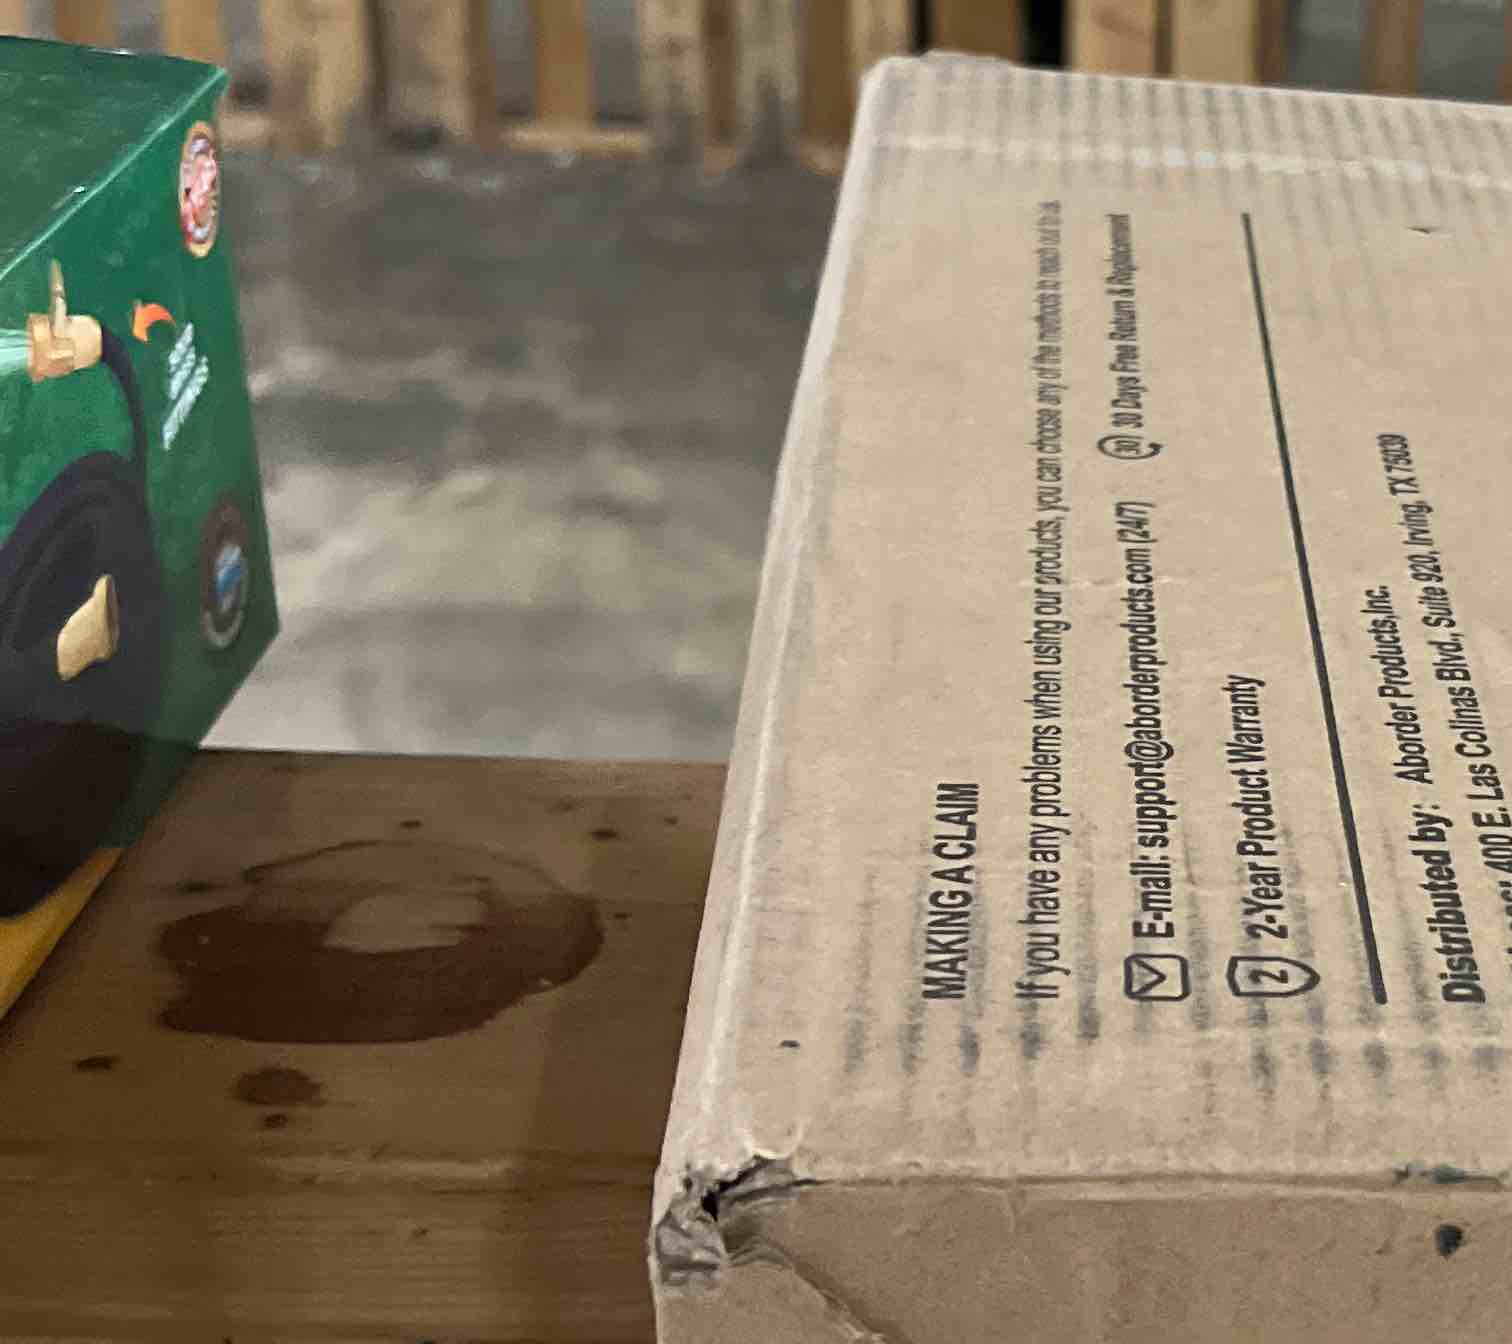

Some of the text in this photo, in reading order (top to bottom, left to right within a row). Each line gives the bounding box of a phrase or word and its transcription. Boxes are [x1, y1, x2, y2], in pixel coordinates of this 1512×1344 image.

[1106, 288, 1136, 297] &
[1108, 300, 1138, 342] Return
[1031, 345, 1062, 364] the
[1032, 365, 1062, 379] of
[1109, 344, 1141, 372] Free
[1037, 382, 1069, 406] any
[1110, 376, 1149, 409] Days
[1025, 408, 1063, 454] choose
[1111, 412, 1143, 429] 30
[1036, 457, 1062, 483] can
[1388, 475, 1421, 496] TX
[1037, 485, 1070, 512] you
[1397, 500, 1434, 546] Irving,
[1027, 516, 1068, 584] products,
[1405, 550, 1444, 583] 920,
[1033, 587, 1062, 616] our
[1418, 585, 1456, 628] Suite
[1024, 620, 1071, 665] using
[1427, 633, 1472, 682] Blvd.,
[1023, 670, 1062, 719] when
[1115, 501, 1177, 939] E-mail: support@aborderproducts.com (24/7)
[1447, 686, 1492, 757] Colinas
[1383, 702, 1433, 785] Aborder
[1020, 724, 1072, 818] problems
[1466, 763, 1504, 800] Las
[1221, 674, 1291, 940] 2-Year Product Warranty
[1408, 804, 1453, 842] by:
[1470, 806, 1512, 828] E.
[1029, 823, 1072, 863] any
[922, 783, 980, 999] MAKING A CLAIM
[1017, 869, 1061, 925] have
[1410, 850, 1486, 1004] Distributed
[1026, 932, 1071, 977] you
[1015, 980, 1060, 999] If
